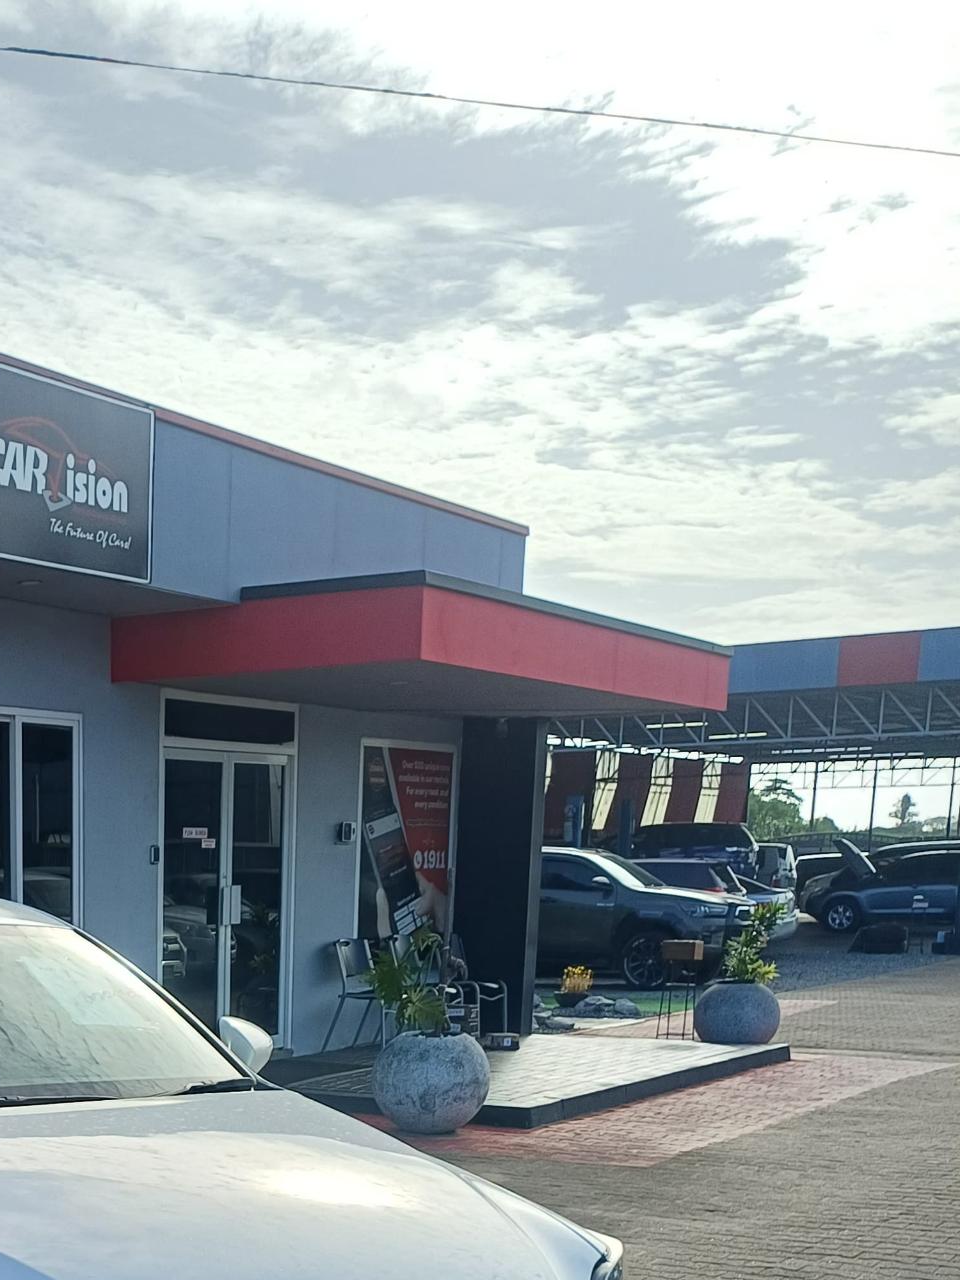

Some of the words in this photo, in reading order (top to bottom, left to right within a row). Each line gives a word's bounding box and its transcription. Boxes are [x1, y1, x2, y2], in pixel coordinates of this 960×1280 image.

[50, 518, 64, 533] The
[65, 522, 94, 540] Future
[96, 530, 108, 548] Of
[423, 850, 446, 869] 1911
